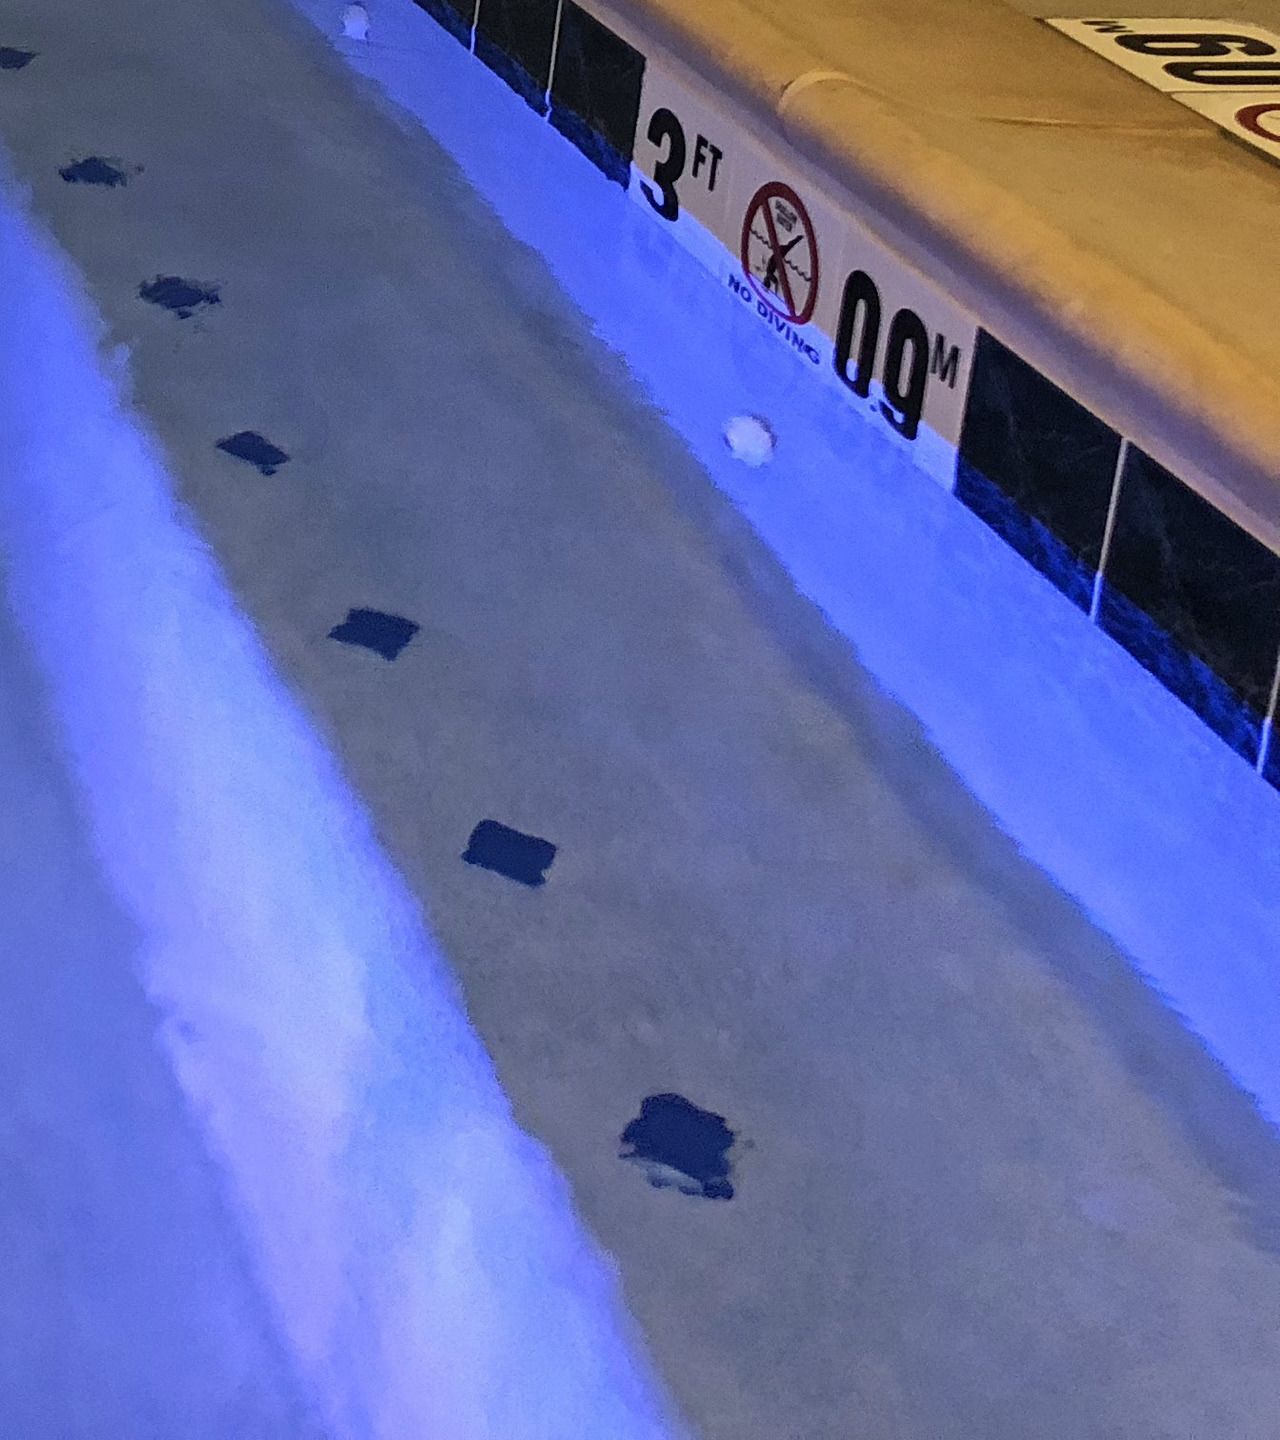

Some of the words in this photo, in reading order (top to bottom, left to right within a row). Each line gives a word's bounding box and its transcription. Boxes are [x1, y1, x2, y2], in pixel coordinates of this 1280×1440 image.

[639, 107, 686, 222] 3
[692, 133, 723, 192] FT
[727, 273, 752, 303] NO
[757, 300, 820, 365] DIVING
[930, 333, 961, 389] M
